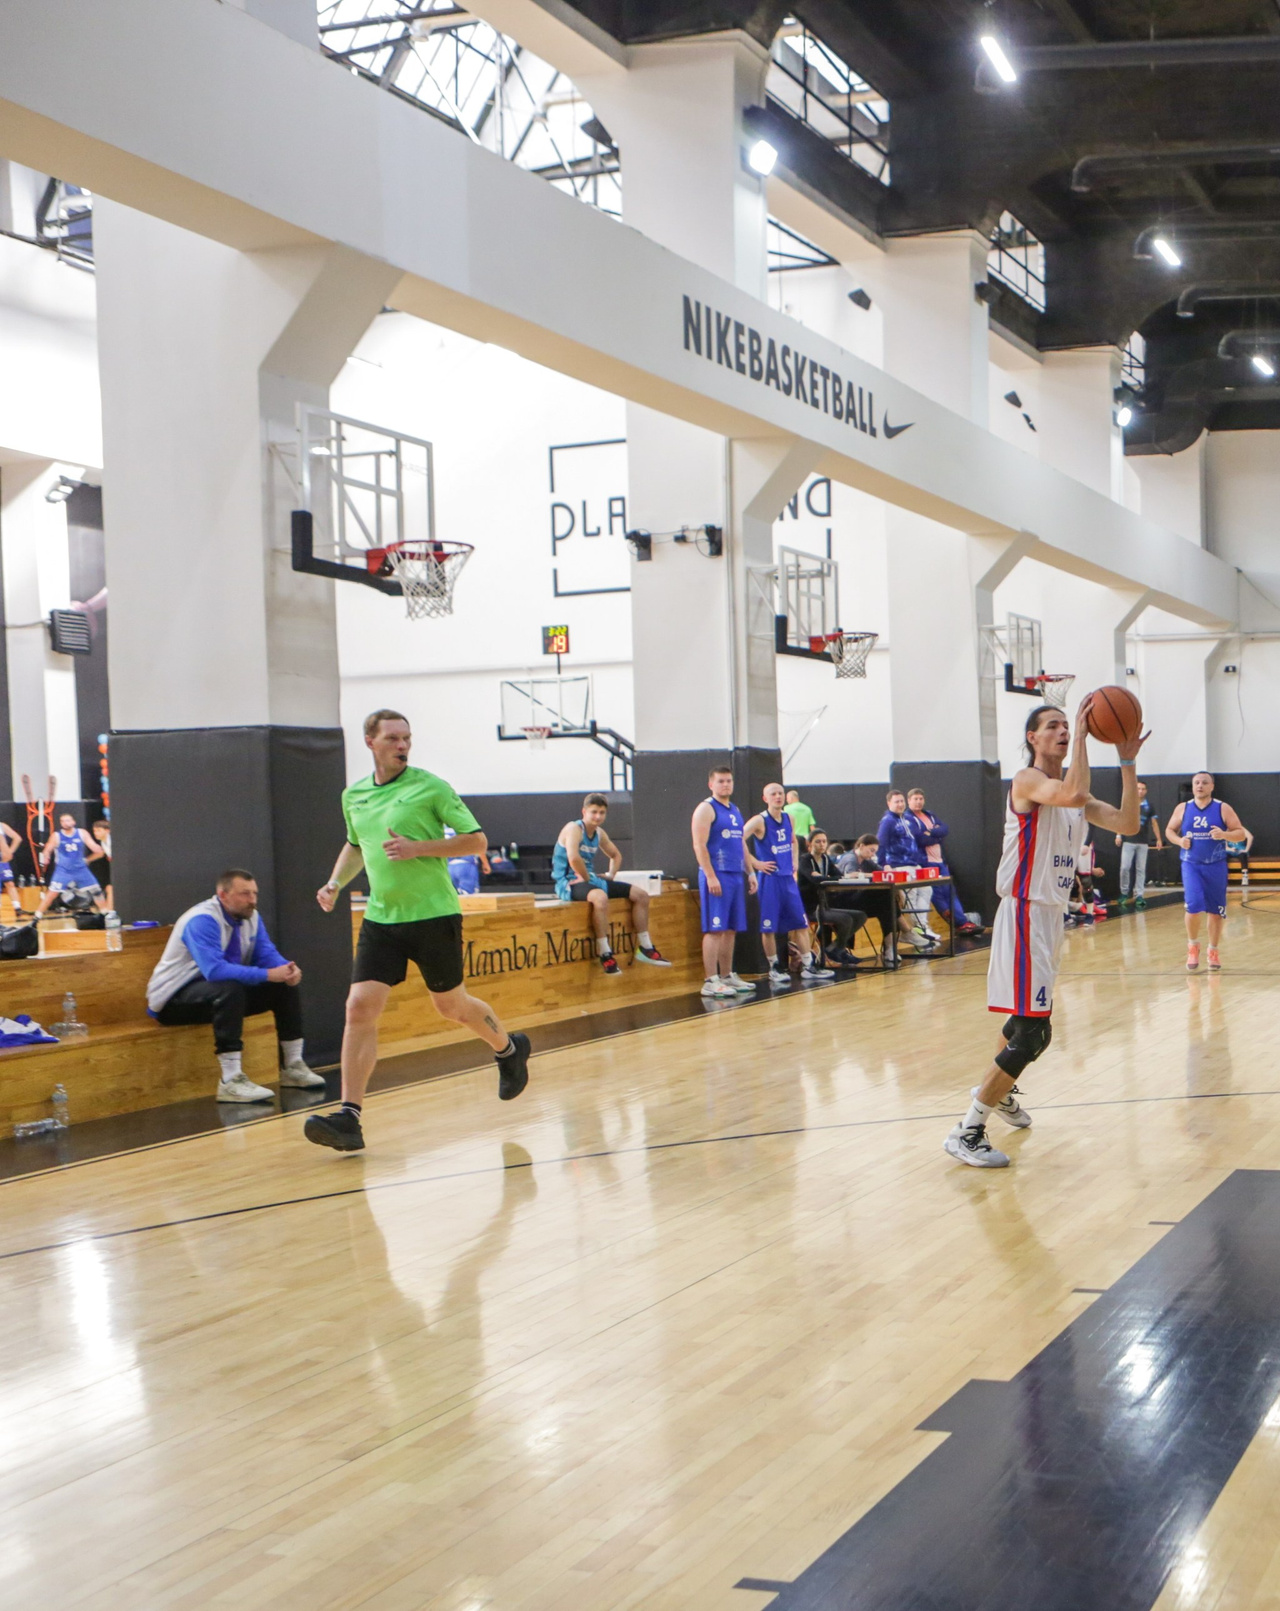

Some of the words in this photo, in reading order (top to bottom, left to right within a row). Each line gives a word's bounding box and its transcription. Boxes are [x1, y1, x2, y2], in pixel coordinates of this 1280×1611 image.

[683, 294, 877, 438] NIKEBASKETBALL
[729, 814, 739, 827] 2
[1193, 816, 1209, 829] 24
[776, 828, 787, 842] 15
[1035, 985, 1047, 1007] 4
